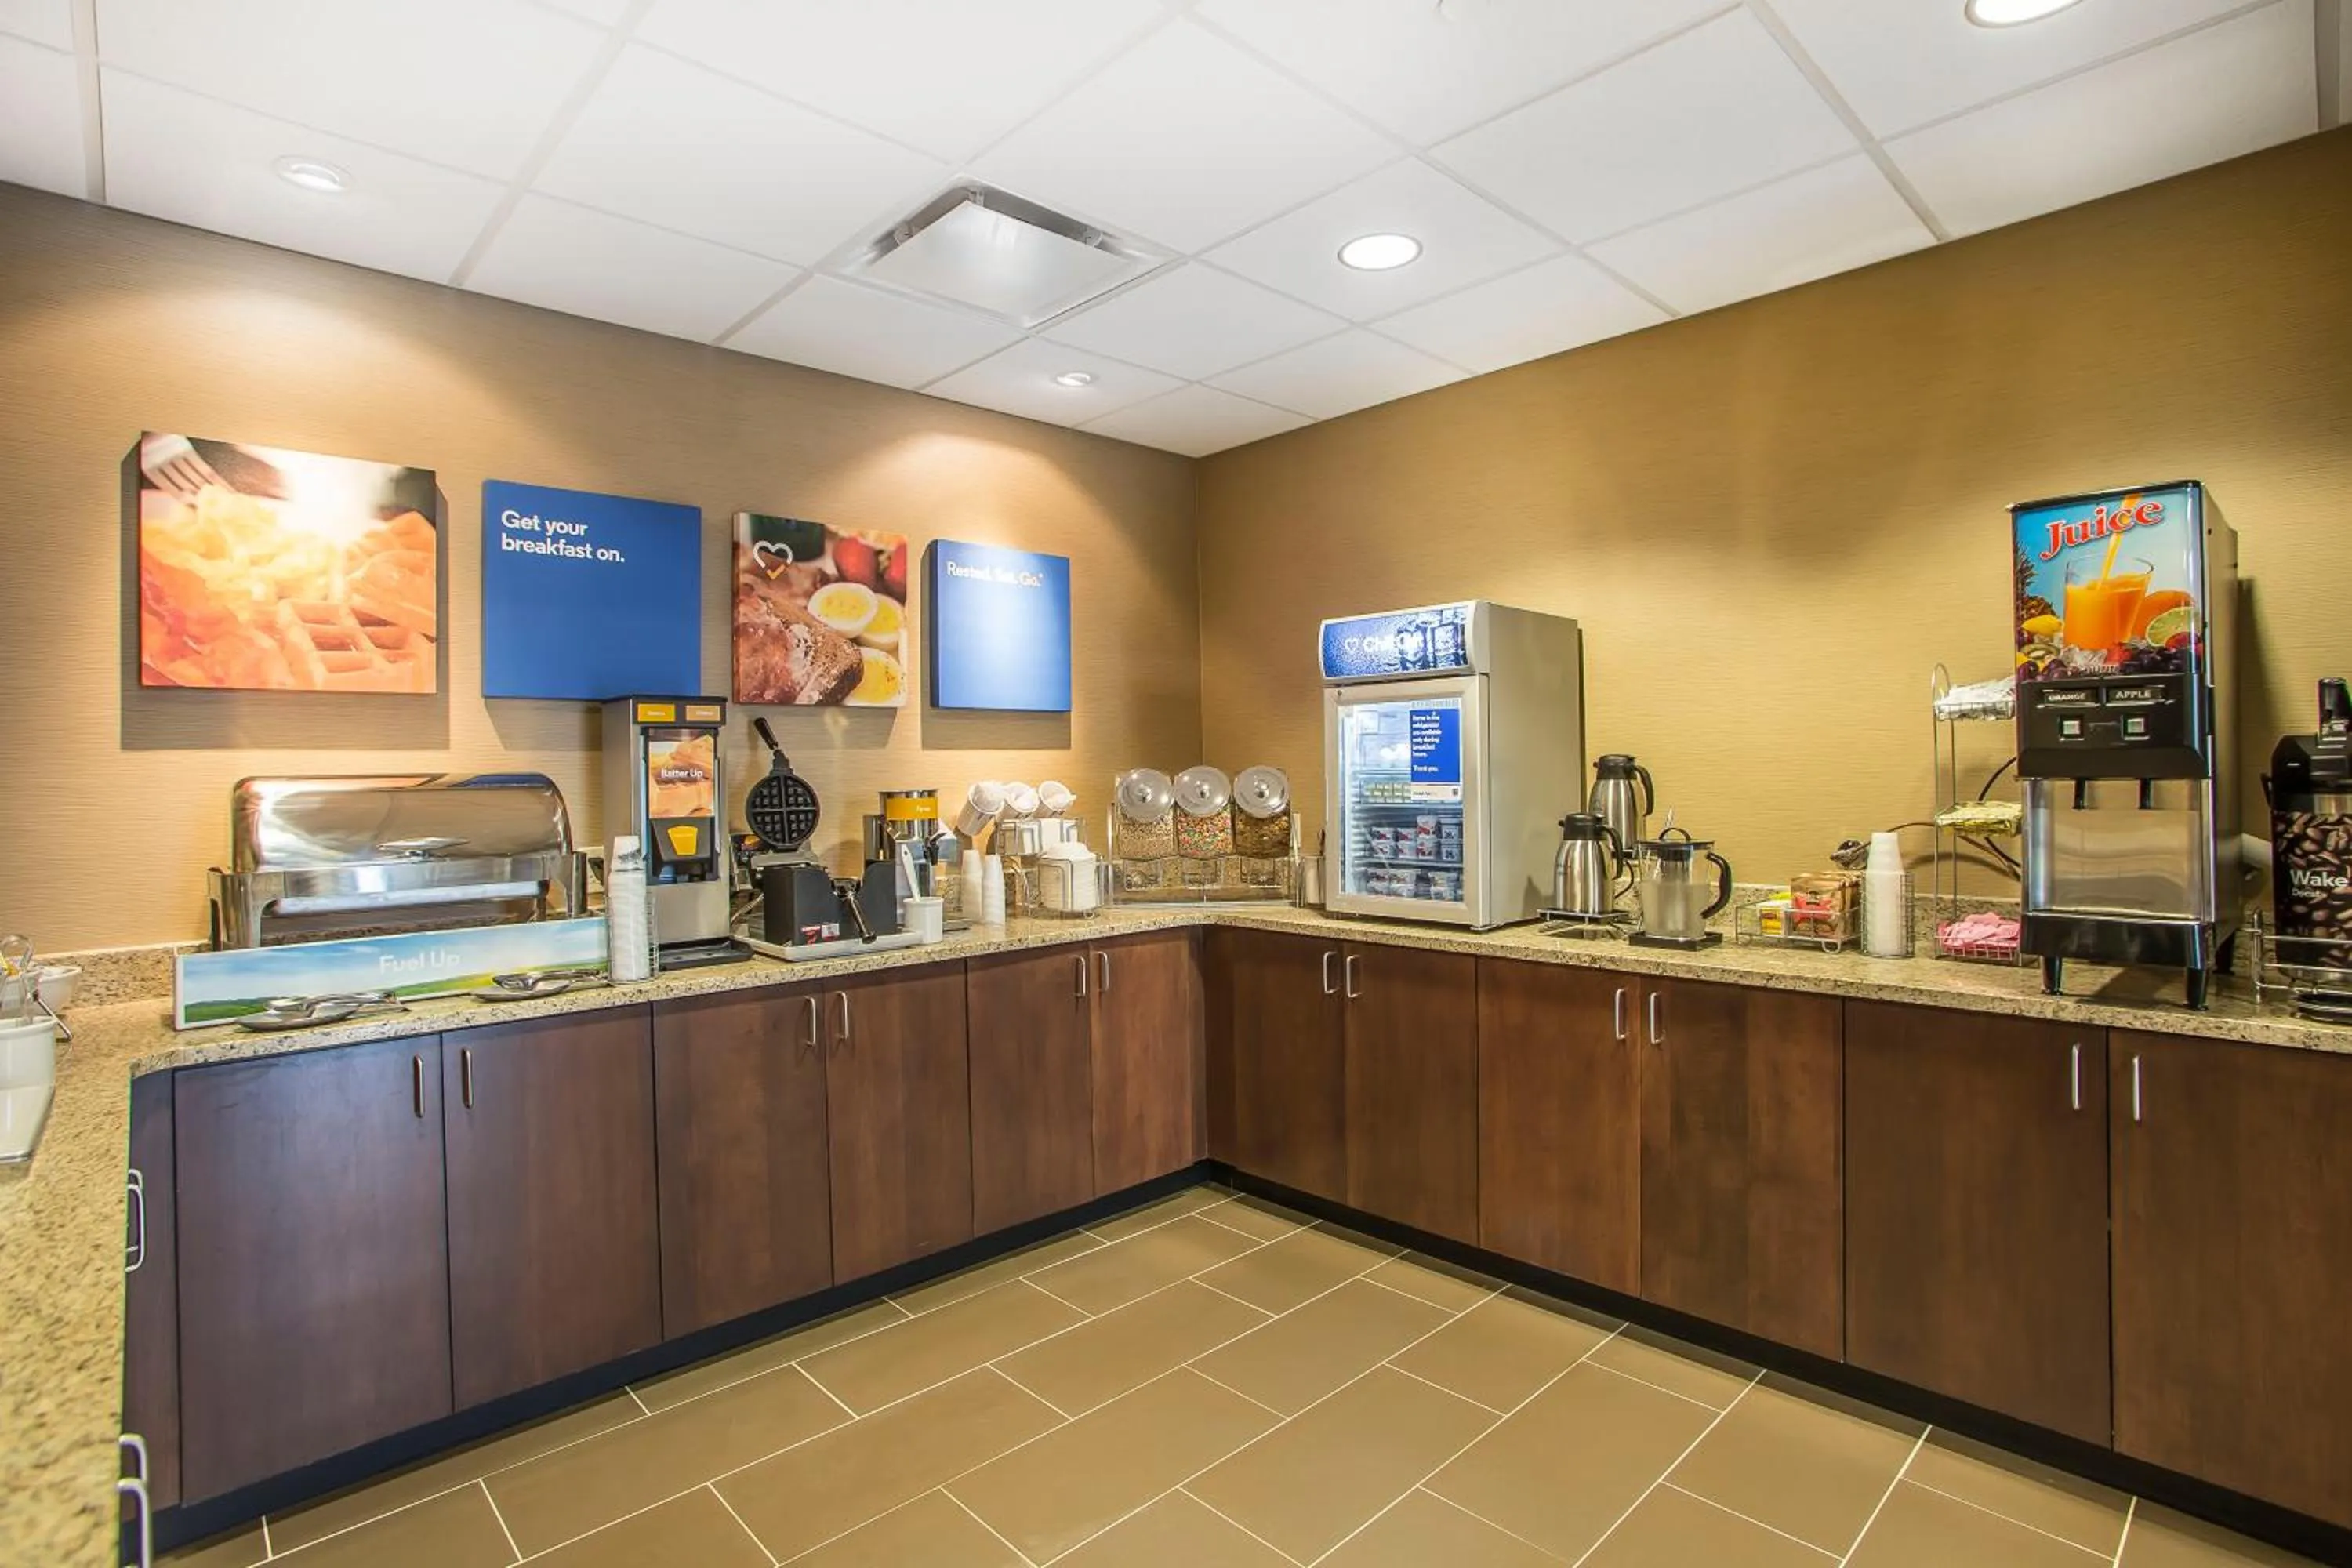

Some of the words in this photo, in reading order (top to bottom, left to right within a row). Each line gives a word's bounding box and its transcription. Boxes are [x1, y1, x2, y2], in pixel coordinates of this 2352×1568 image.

[501, 510, 541, 531] Get
[544, 520, 588, 536] your
[2039, 502, 2165, 560] Juice
[501, 532, 593, 559] breakfast
[597, 547, 626, 562] on.
[2048, 692, 2086, 702] ORANGE
[2115, 689, 2151, 699] APPLE
[661, 768, 688, 779] Batter
[690, 768, 703, 782] Up
[2290, 869, 2349, 887] Wake
[379, 951, 425, 975] Fuel
[430, 948, 461, 972] Up
